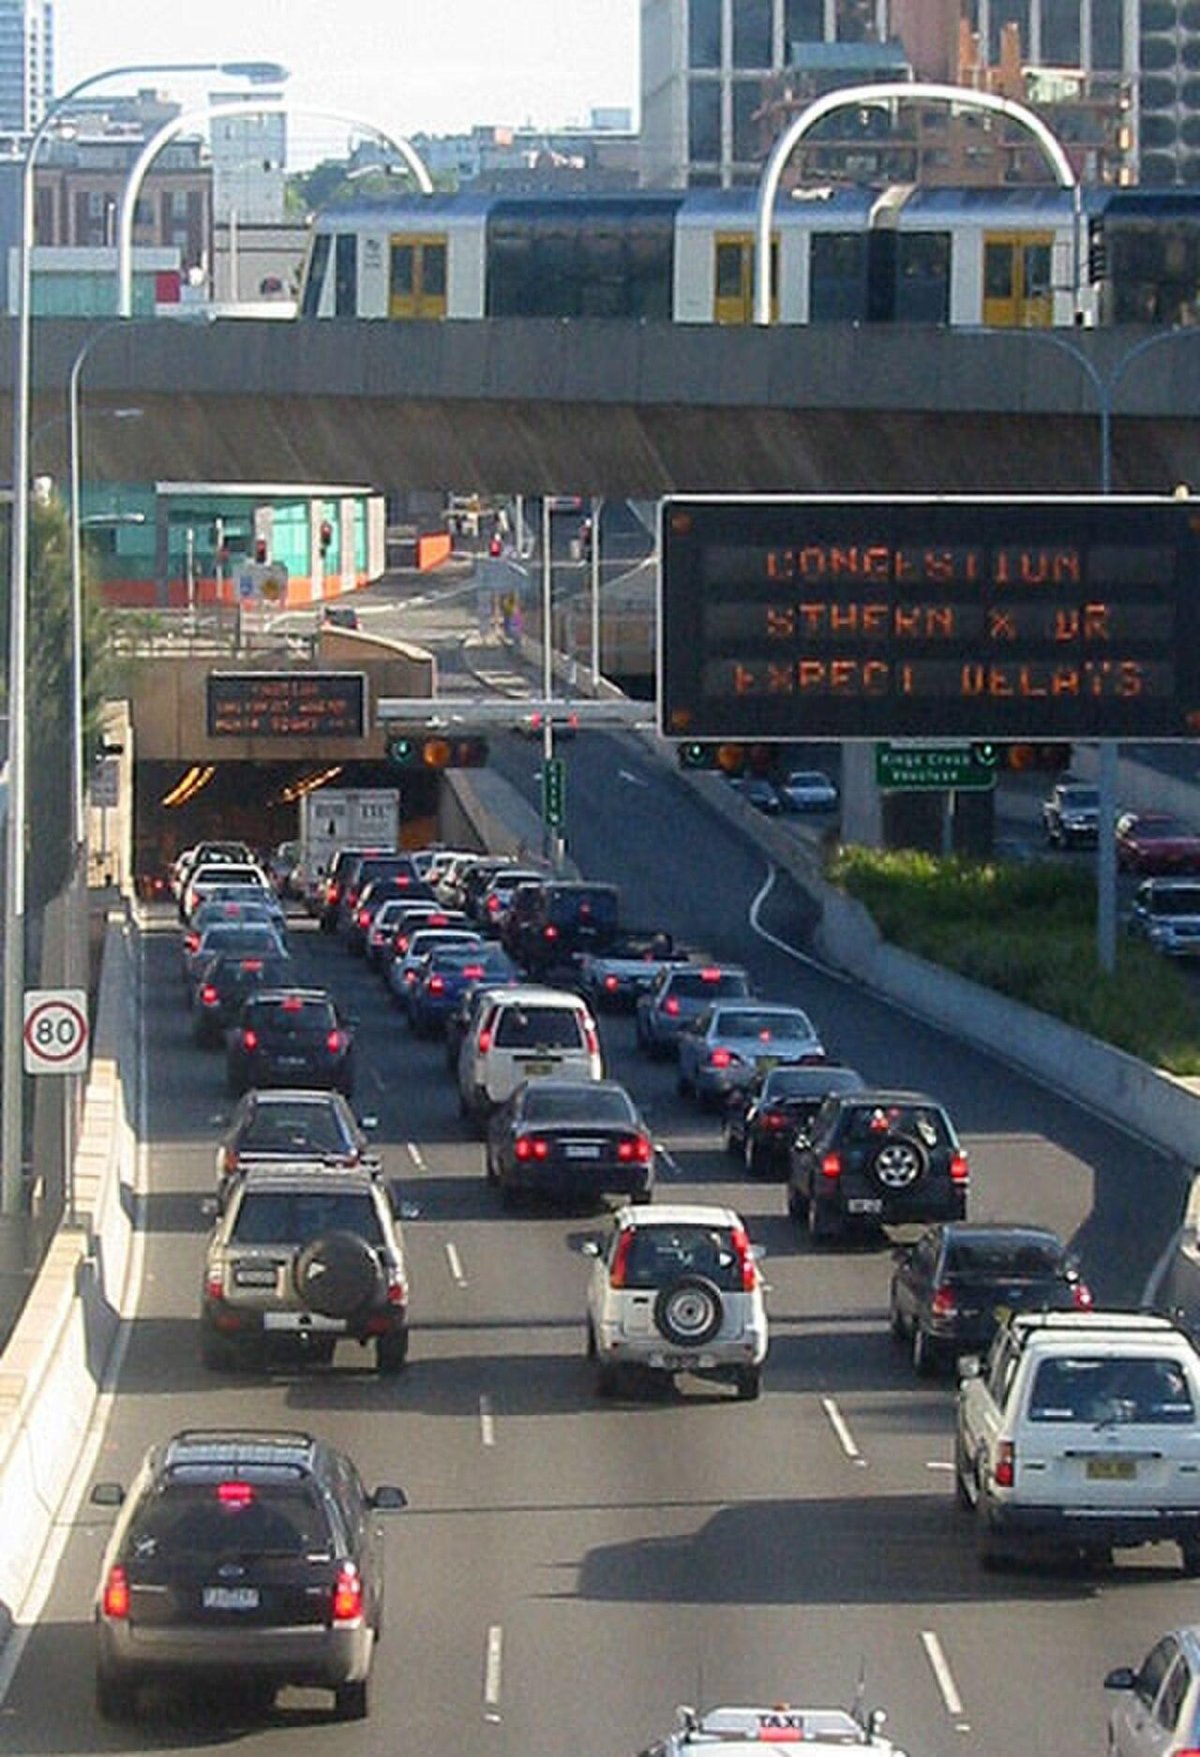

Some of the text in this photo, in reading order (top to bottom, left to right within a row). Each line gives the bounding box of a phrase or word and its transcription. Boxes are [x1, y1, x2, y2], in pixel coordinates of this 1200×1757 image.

[734, 660, 1143, 697] EXPECT DELAYS
[36, 1018, 76, 1045] 80
[756, 1713, 805, 1729] TAXI
